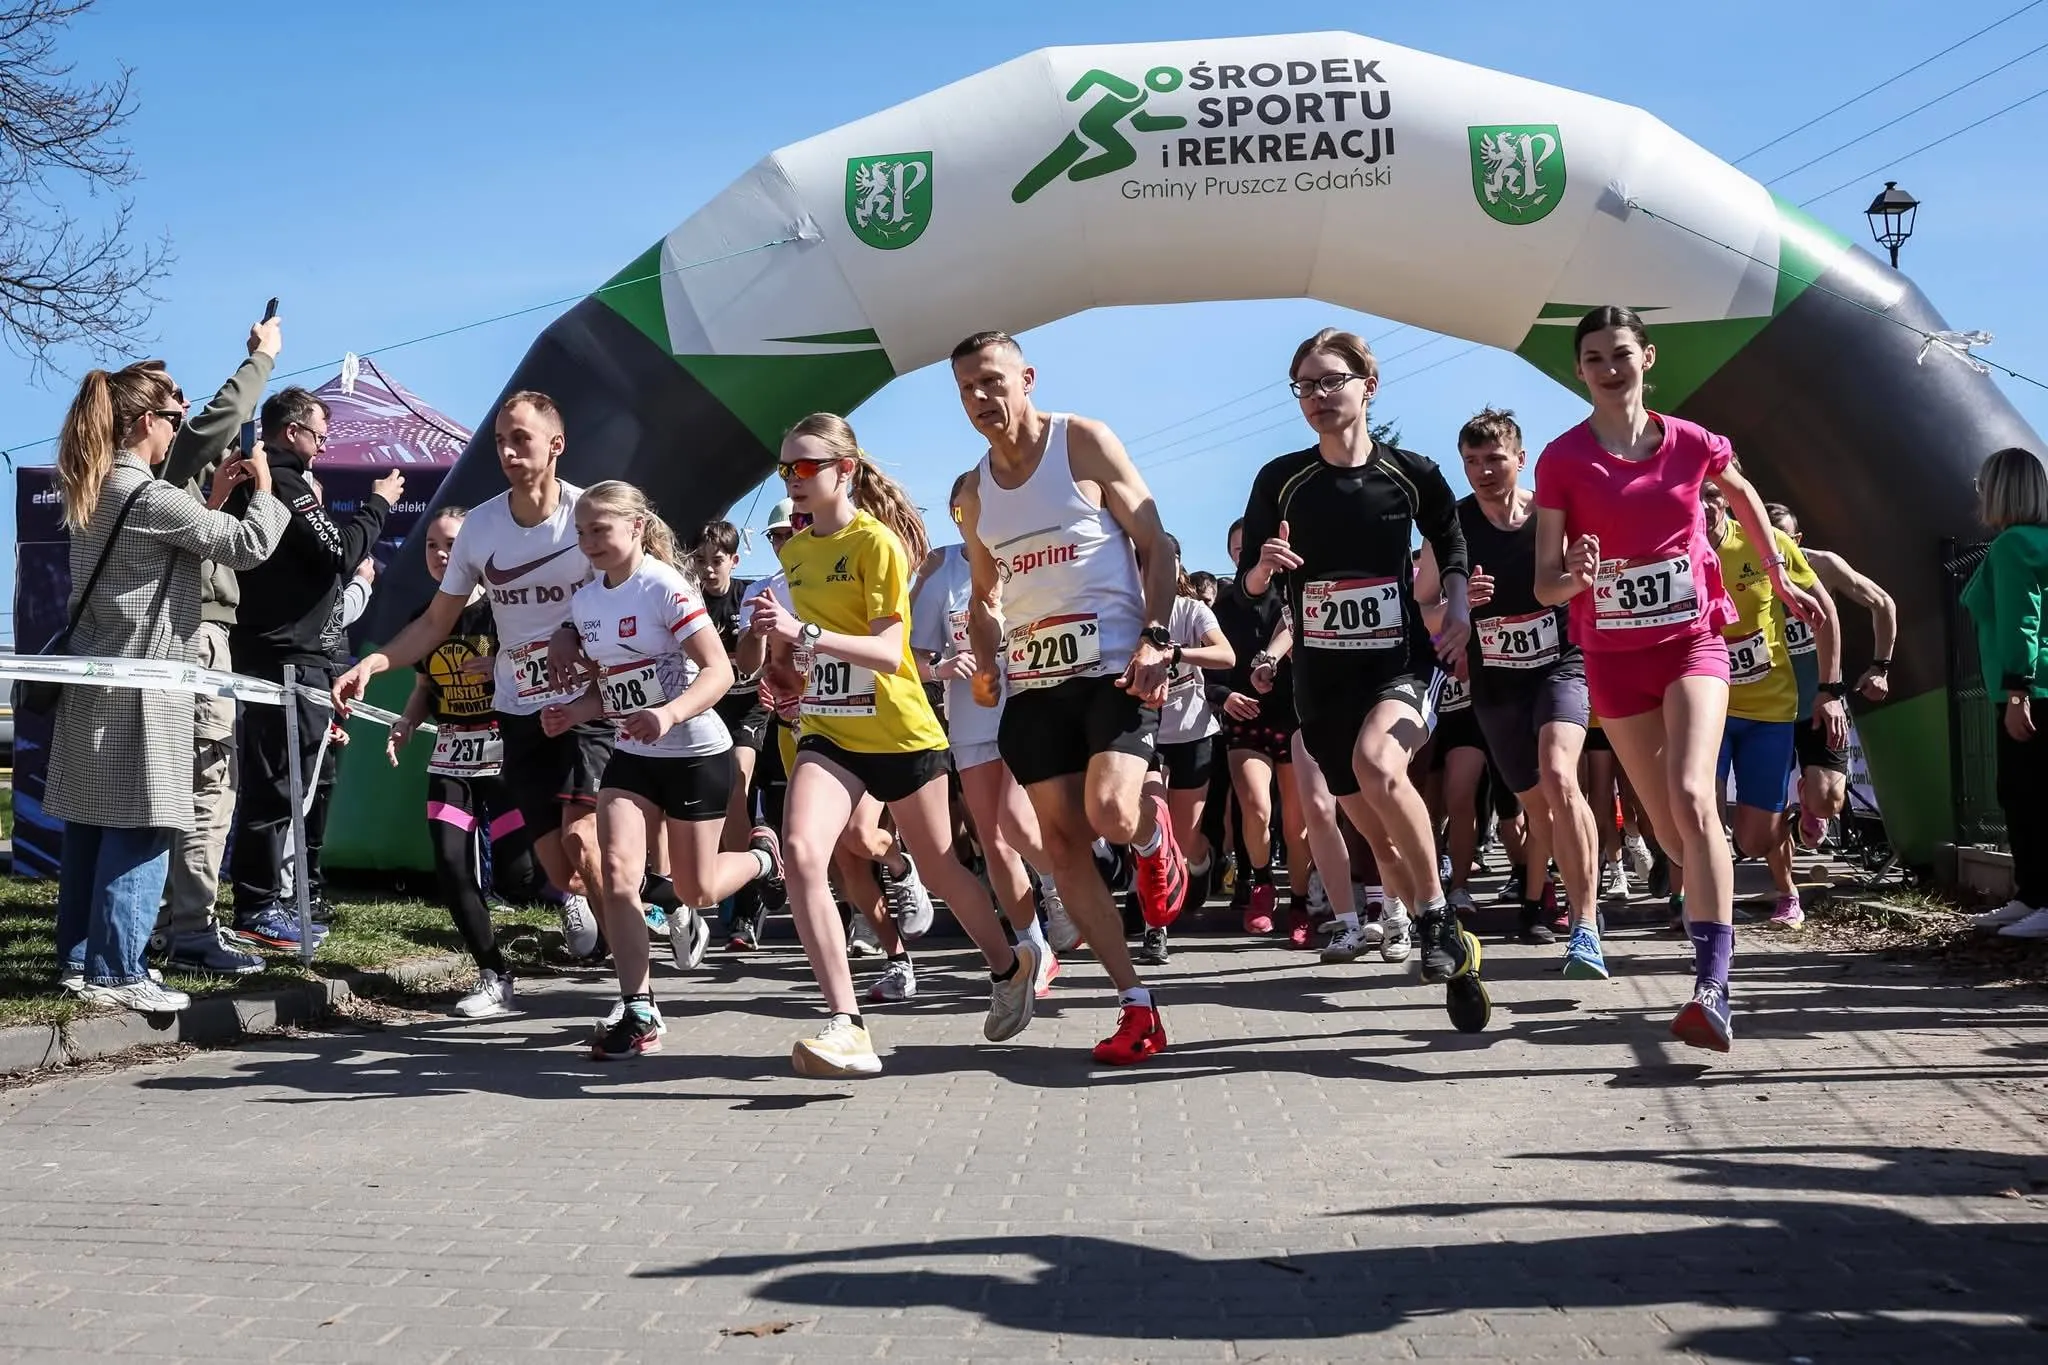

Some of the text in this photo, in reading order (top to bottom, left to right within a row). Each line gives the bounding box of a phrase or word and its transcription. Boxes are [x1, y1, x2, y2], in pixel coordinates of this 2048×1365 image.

[1197, 90, 1391, 129] SPORTU
[1162, 127, 1395, 168] i REKREACJI
[1121, 165, 1392, 201] Gminy Pruszcz Gdański
[1012, 543, 1079, 574] sprint
[492, 587, 529, 605] JUST
[536, 585, 564, 604] DO
[1616, 571, 1671, 610] 337
[1321, 597, 1381, 631] 208
[1027, 633, 1079, 671] 220
[1498, 627, 1541, 654] 281
[444, 685, 486, 699] MISTRZ
[606, 679, 647, 711] 328
[814, 662, 851, 696] 297
[1443, 682, 1464, 701] 34
[449, 738, 485, 762] 237
[255, 924, 279, 939] HOKA
